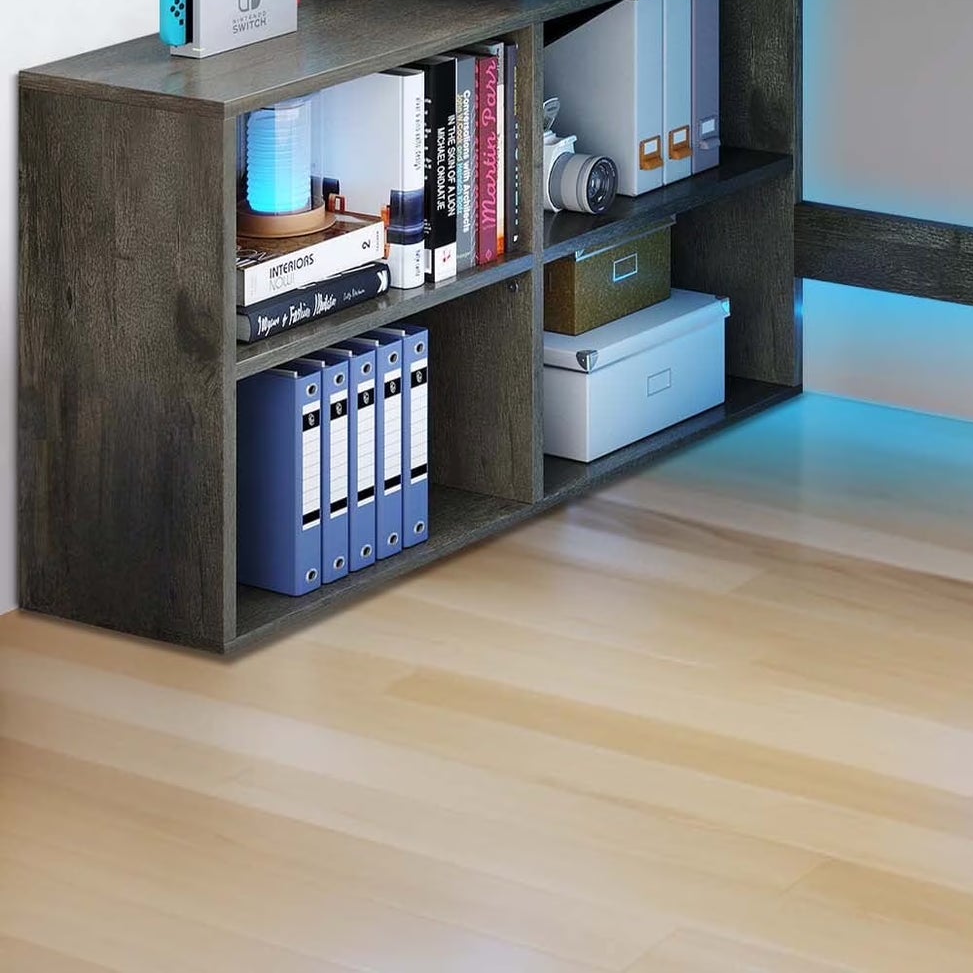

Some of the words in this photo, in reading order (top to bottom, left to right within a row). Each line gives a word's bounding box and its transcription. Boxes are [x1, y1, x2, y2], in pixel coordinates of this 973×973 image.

[233, 17, 267, 34] SWITCH
[482, 60, 497, 127] Parr
[447, 114, 456, 125] IN
[463, 89, 471, 160] Conversations
[437, 127, 446, 165] MICHAEL
[447, 126, 456, 146] THE
[447, 147, 456, 169] SKIN
[447, 170, 456, 184] OF
[463, 161, 471, 182] with
[482, 132, 497, 231] Martin
[447, 194, 456, 217] LION
[463, 184, 471, 233] Architects
[361, 239, 371, 250] 2
[269, 253, 315, 279] INTERIORS
